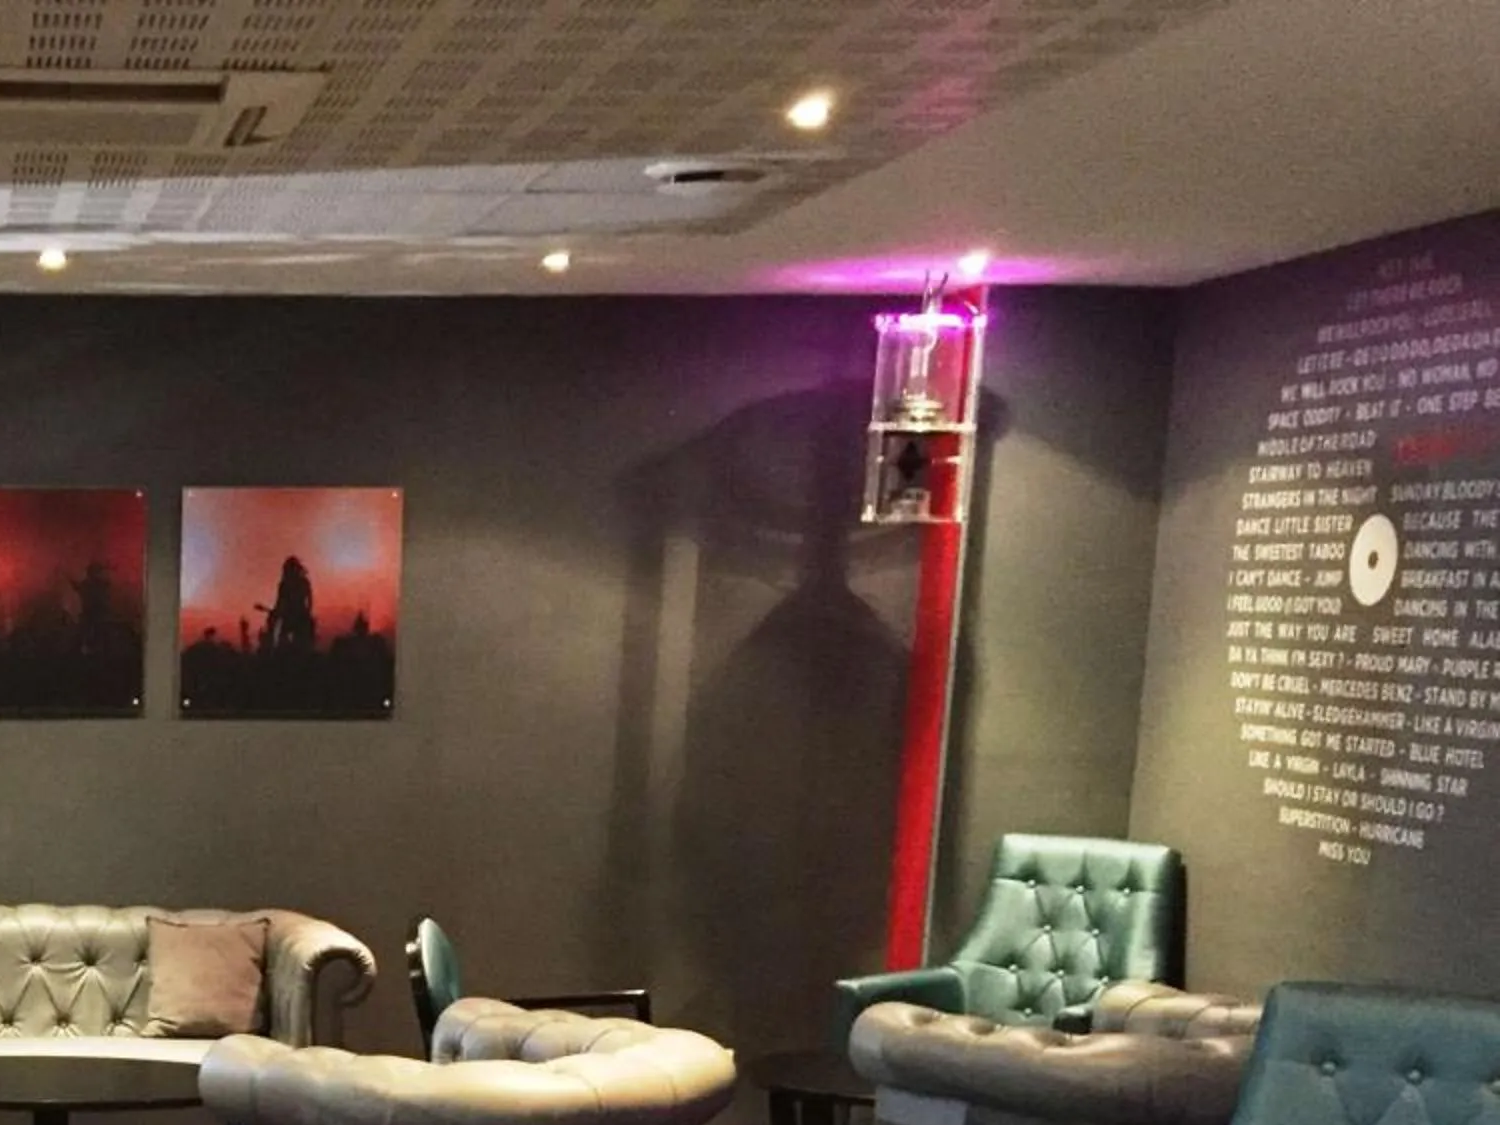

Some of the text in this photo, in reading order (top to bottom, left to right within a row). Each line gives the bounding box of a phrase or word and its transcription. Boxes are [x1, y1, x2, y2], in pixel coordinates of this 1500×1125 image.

[1424, 685, 1467, 706] STAND
[1414, 715, 1442, 735] LIKE
[1437, 774, 1469, 797] STAR
[1360, 792, 1407, 816] SHOULD
[1415, 801, 1435, 821] GO
[1359, 820, 1425, 850] HURRICANE
[1346, 847, 1372, 866] YOU
